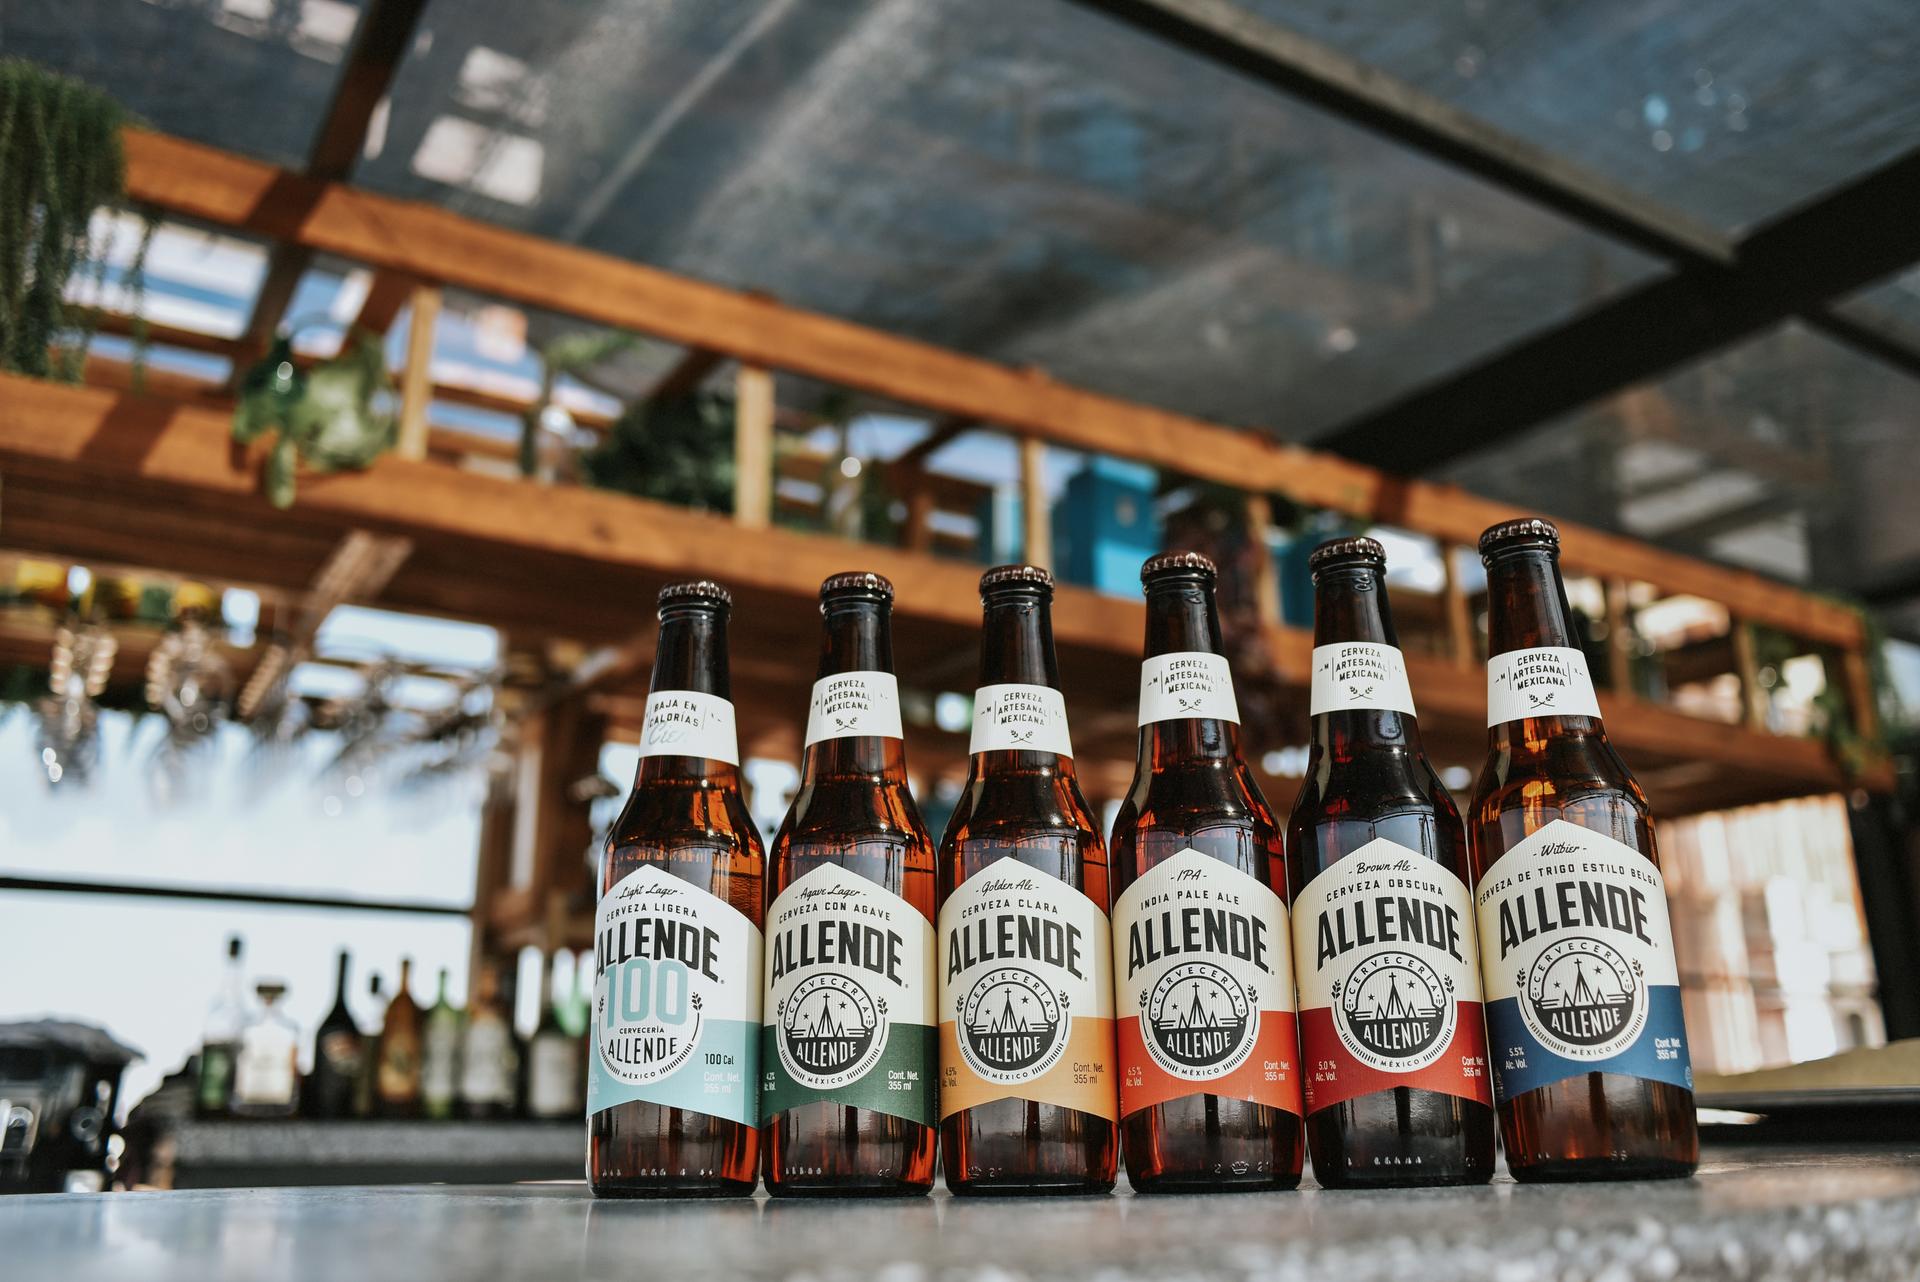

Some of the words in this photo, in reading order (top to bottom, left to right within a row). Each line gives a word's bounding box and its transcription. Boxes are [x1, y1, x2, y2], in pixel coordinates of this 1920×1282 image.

[1341, 647, 1382, 658] CERVEZA
[1169, 660, 1209, 671] CERVEZA
[1336, 659, 1387, 673] ARTESANAL
[1517, 653, 1560, 667] CERVEZA
[1164, 671, 1215, 685] ARTESANAL
[1339, 670, 1385, 682] MEXICANA
[1512, 664, 1567, 682] ARTESANAL
[828, 680, 865, 693] CERVEZA
[1168, 682, 1212, 695] MEXICANA
[1517, 676, 1566, 691] MEXICANA
[824, 690, 871, 707] ARTESANAL
[1004, 692, 1043, 703] CERVEZA
[654, 699, 678, 712] BAJA
[684, 701, 697, 711] EN
[827, 702, 869, 716] MEXICANA
[998, 703, 1048, 717] ARTESANAL
[649, 710, 699, 728] CALORÍAS
[1001, 714, 1045, 725] MEXICANA
[1540, 842, 1580, 857] Witbier
[1356, 862, 1391, 874] Brown
[1393, 860, 1410, 872] Ale
[1177, 869, 1202, 881] IPA
[619, 883, 643, 900] Light
[645, 883, 678, 898] Lager
[981, 879, 1013, 897] Golden
[1015, 879, 1033, 891] Ale
[1326, 880, 1380, 902] CERVEZA
[1388, 879, 1443, 896] OBSCURA
[1479, 877, 1513, 906] CERVEZA
[1518, 870, 1531, 883] DE
[1538, 863, 1575, 877] TRIGO
[1583, 863, 1625, 875] ESTILO
[1630, 868, 1657, 887] BELGA
[800, 887, 827, 901] Agave
[827, 884, 861, 899] Lager
[1140, 893, 1169, 910] INDIA
[1177, 890, 1209, 899] PALE
[1217, 892, 1239, 905] ALE
[606, 903, 647, 923] CERVEZA
[654, 903, 698, 918] LIGERA
[779, 903, 819, 924] CERVEZA
[824, 902, 847, 911] CON
[853, 904, 891, 922] AGAVE
[962, 899, 1010, 919] CERVEZA
[1018, 899, 1058, 915] CLARA
[1500, 881, 1652, 961] ALLENDE
[1317, 896, 1463, 971] ALLENDE
[595, 917, 721, 986] ALLENDE
[948, 914, 1083, 987] ALLENDE
[1128, 908, 1269, 982] ALLENDE
[771, 920, 904, 989] ALLENDE
[1534, 942, 1627, 983] CERVECERÍA
[1350, 956, 1438, 995] CERVECERÍA
[969, 972, 1052, 1010] CERVECERÍA
[1155, 966, 1241, 1004] CERVECERÍA
[604, 957, 688, 1030] 100
[789, 978, 870, 1014] CERVECERÍA
[1551, 1007, 1621, 1038] ALLENDE
[619, 1025, 665, 1035] CERVECERÍA
[1363, 1022, 1430, 1050] ALLENDE
[607, 1037, 678, 1065] ALLENDE
[979, 1036, 1041, 1063] ALLENDE
[1167, 1032, 1231, 1059] ALLENDE
[1509, 1046, 1524, 1057] 5.5%
[1571, 1046, 1612, 1056] MÉXICO
[705, 1053, 722, 1065] 100
[723, 1055, 734, 1065] Cal
[796, 1042, 857, 1067] ALLENDE
[1073, 1062, 1092, 1073] Cont.
[1093, 1063, 1104, 1073] Net.
[1264, 1061, 1279, 1070] Cont.
[1380, 1059, 1419, 1067] MÉXICO
[1505, 1060, 1515, 1070] Alc.
[1516, 1058, 1528, 1069] Vol.
[622, 1071, 657, 1080] MÉXICO
[888, 1070, 905, 1079] Cont.
[906, 1071, 920, 1080] Net.
[1073, 1074, 1088, 1084] 355
[1089, 1075, 1098, 1084] ml
[1181, 1068, 1220, 1076] MÉXICO
[1264, 1072, 1277, 1081] 355
[1315, 1073, 1325, 1082] Alc.
[1326, 1071, 1338, 1080] Vol.
[1463, 1068, 1474, 1077] 355
[807, 1076, 844, 1084] MÉXICO
[888, 1081, 901, 1091] 355
[903, 1082, 912, 1090] ml
